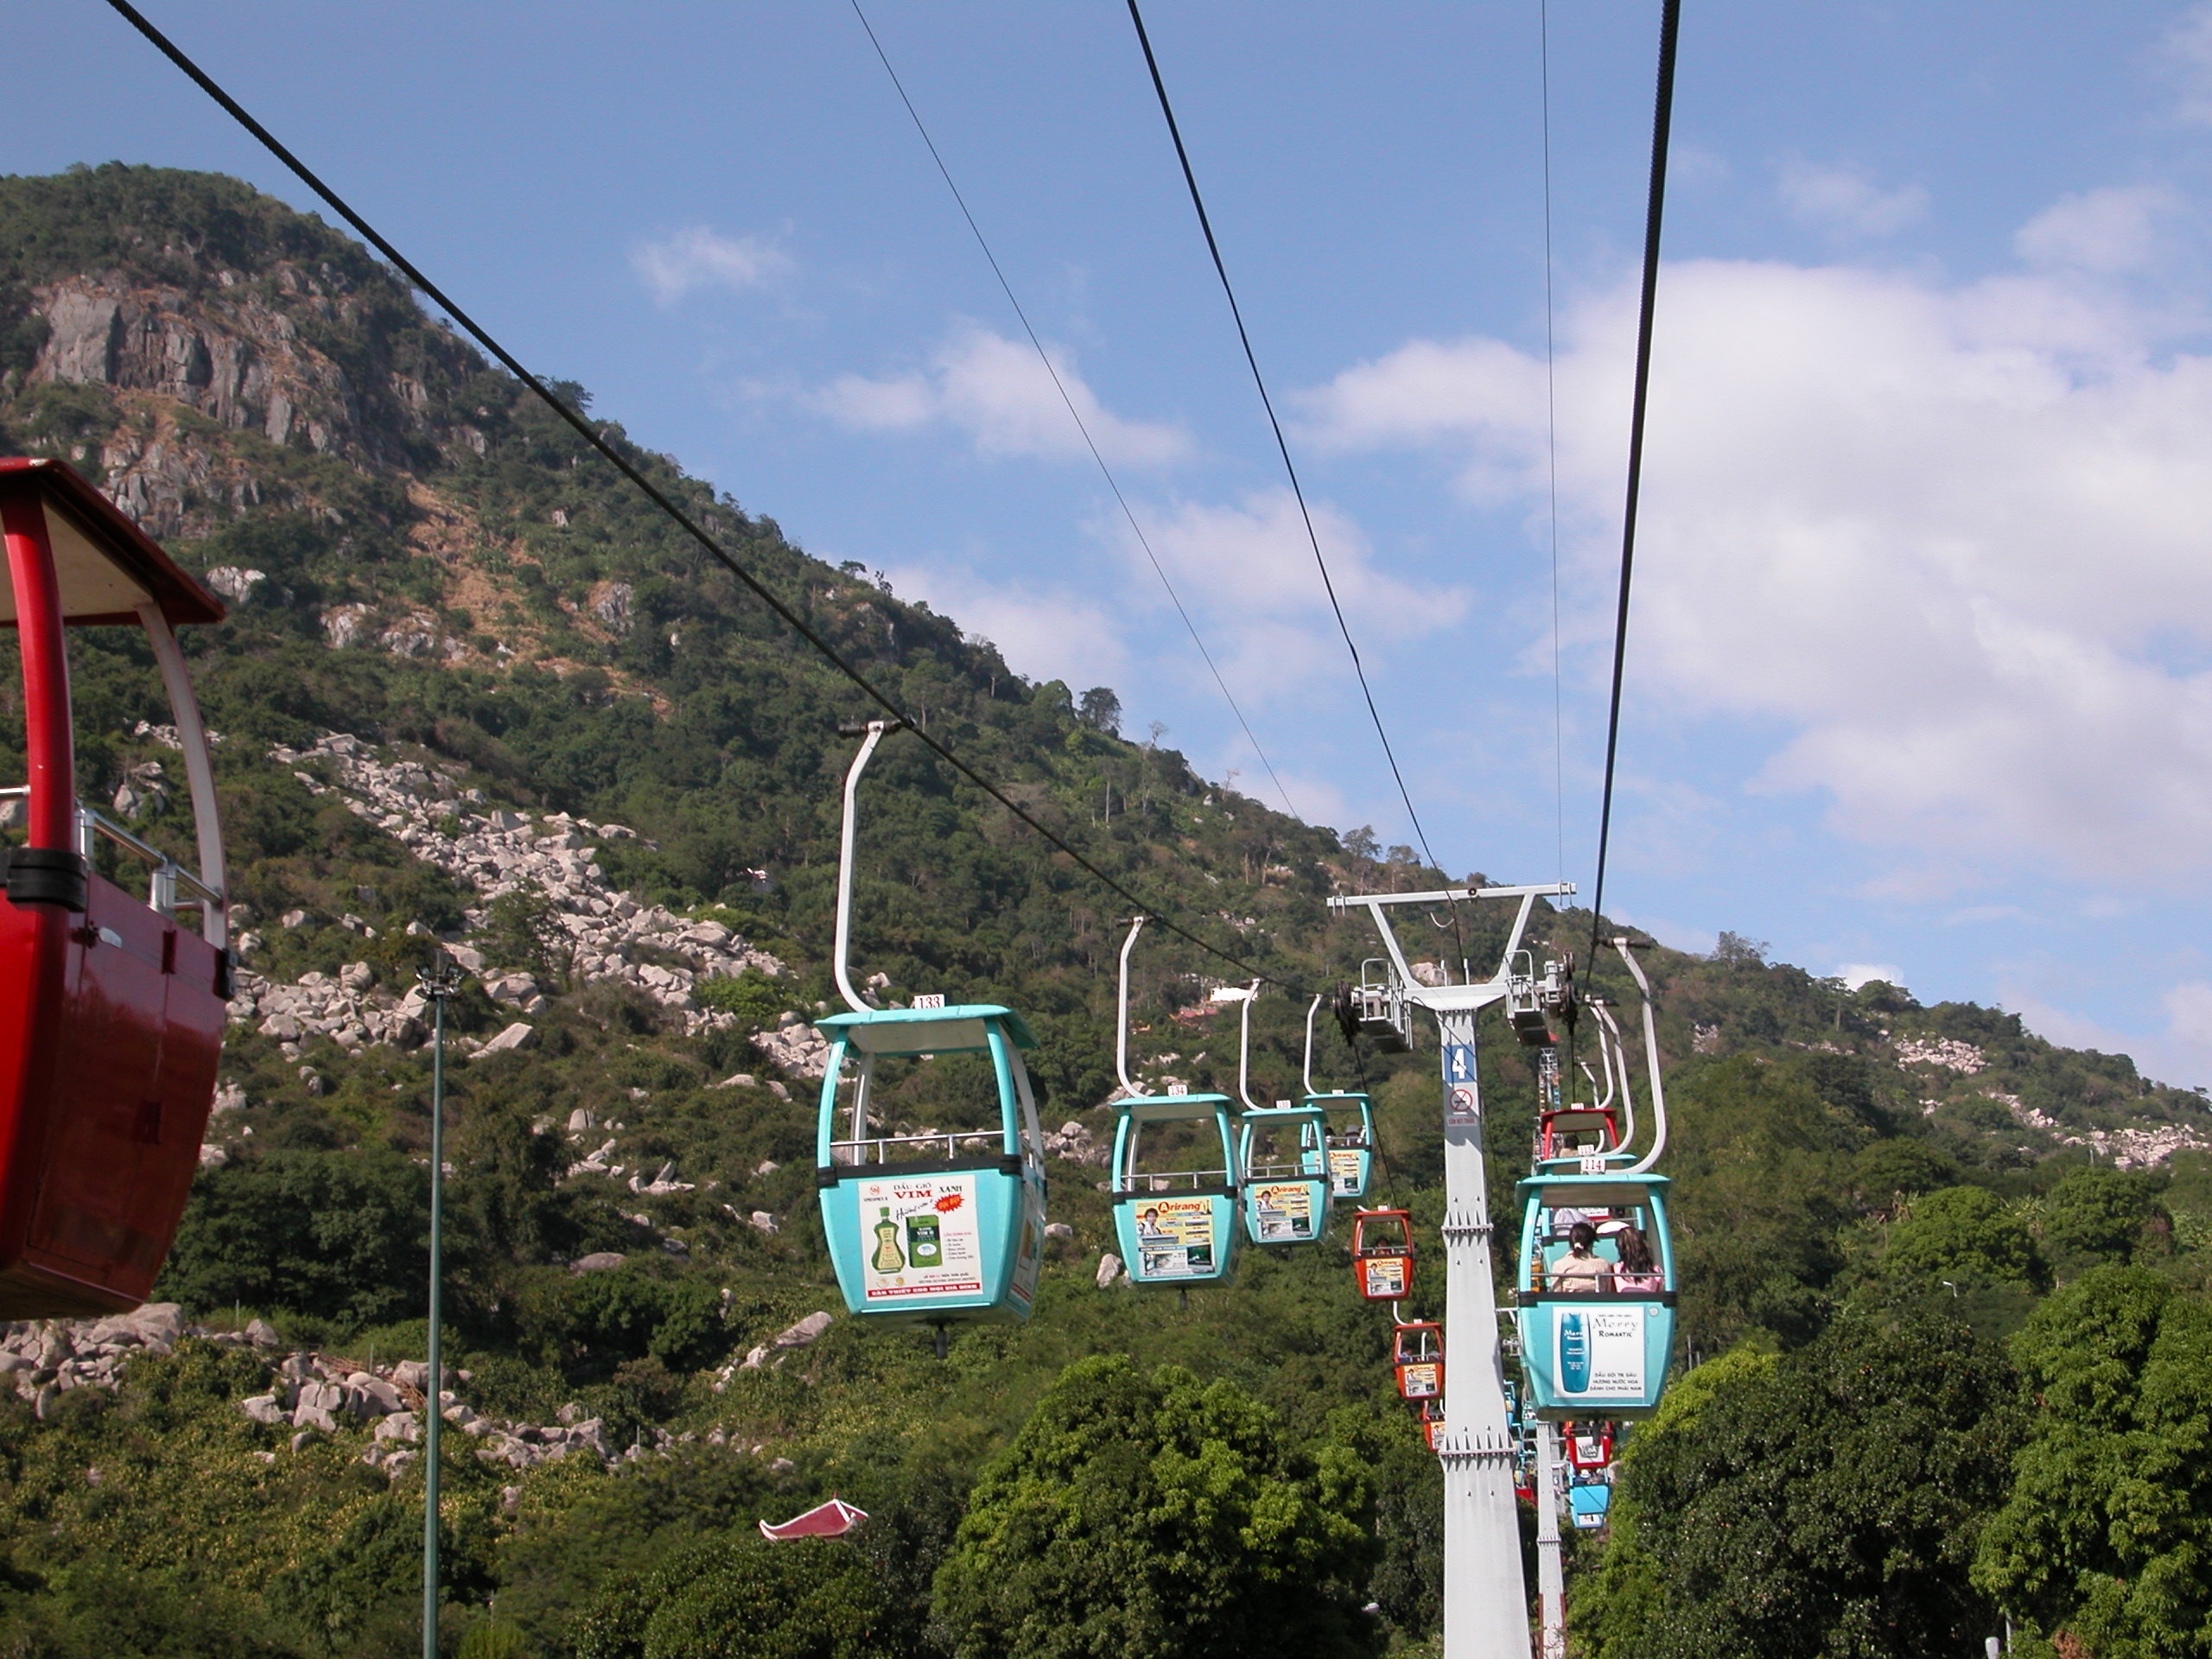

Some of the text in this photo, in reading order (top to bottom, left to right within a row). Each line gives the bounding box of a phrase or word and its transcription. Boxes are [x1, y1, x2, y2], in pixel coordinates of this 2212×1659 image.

[919, 995, 940, 1008] 133
[1452, 1048, 1466, 1079] 4
[1172, 1085, 1184, 1095] 134
[1586, 1160, 1601, 1170] 114
[894, 1190, 932, 1198] VIM
[1271, 1185, 1301, 1194] Arirang
[1159, 1201, 1200, 1213] Arirang
[1592, 1319, 1638, 1331] Merry
